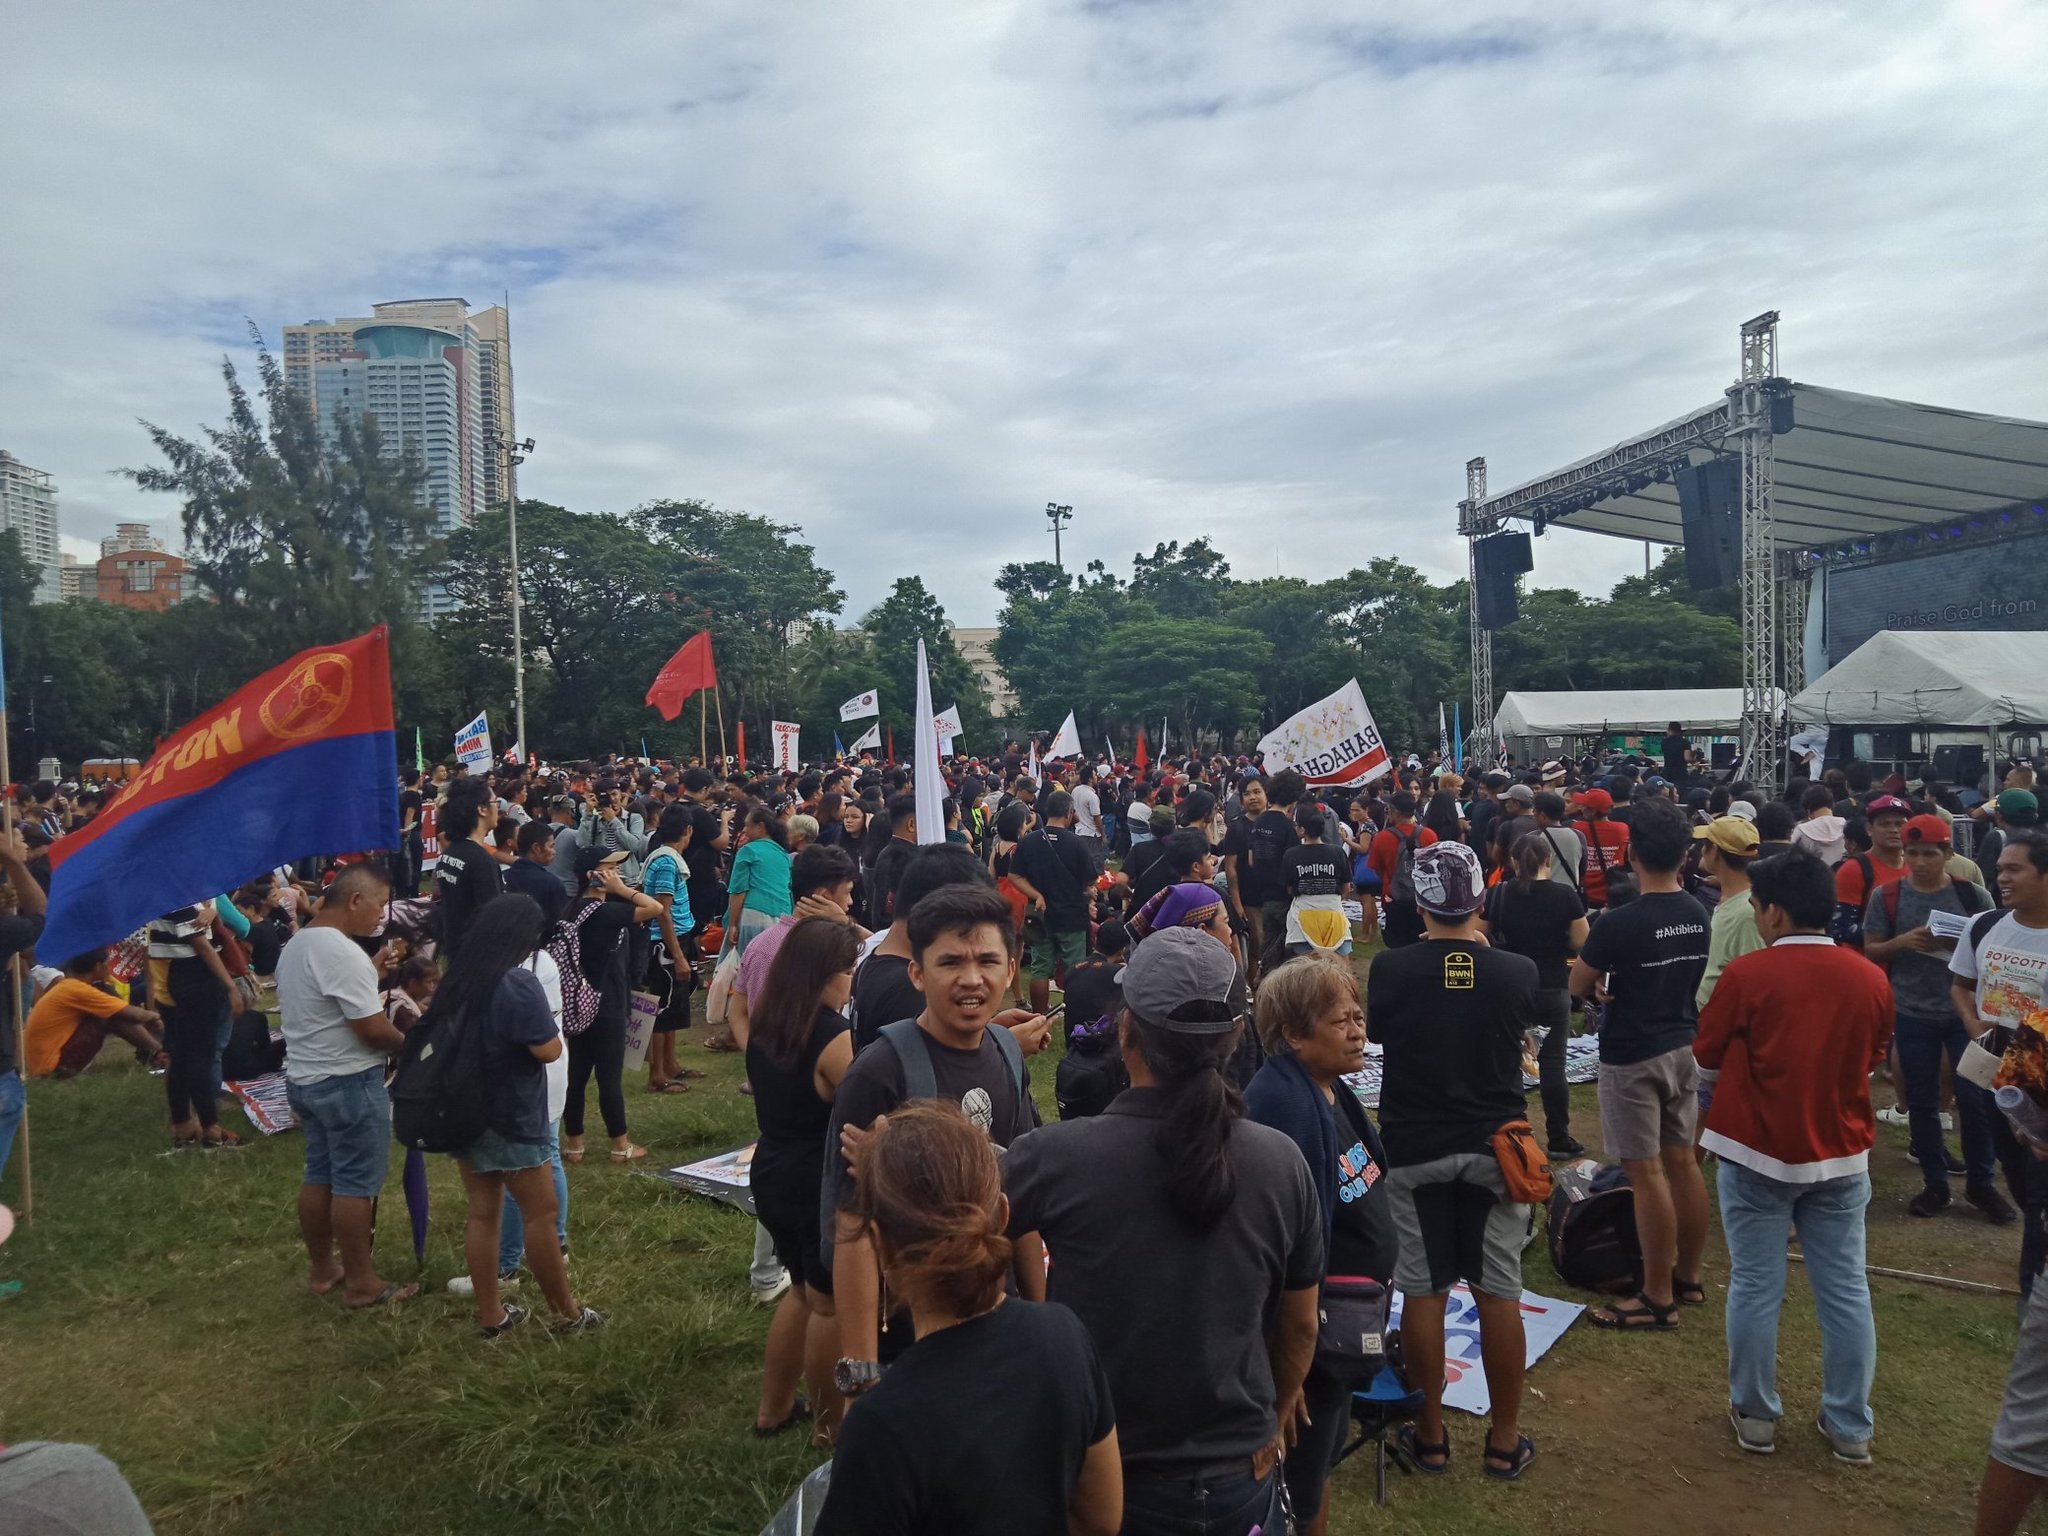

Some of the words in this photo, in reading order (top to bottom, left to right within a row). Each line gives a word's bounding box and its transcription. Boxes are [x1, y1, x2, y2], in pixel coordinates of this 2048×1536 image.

[1887, 609, 1937, 627] Praise
[1943, 601, 1983, 622] God
[1990, 599, 2036, 616] from
[1655, 924, 1704, 939] #Aktibista
[1985, 950, 2047, 970] BOYCOTT
